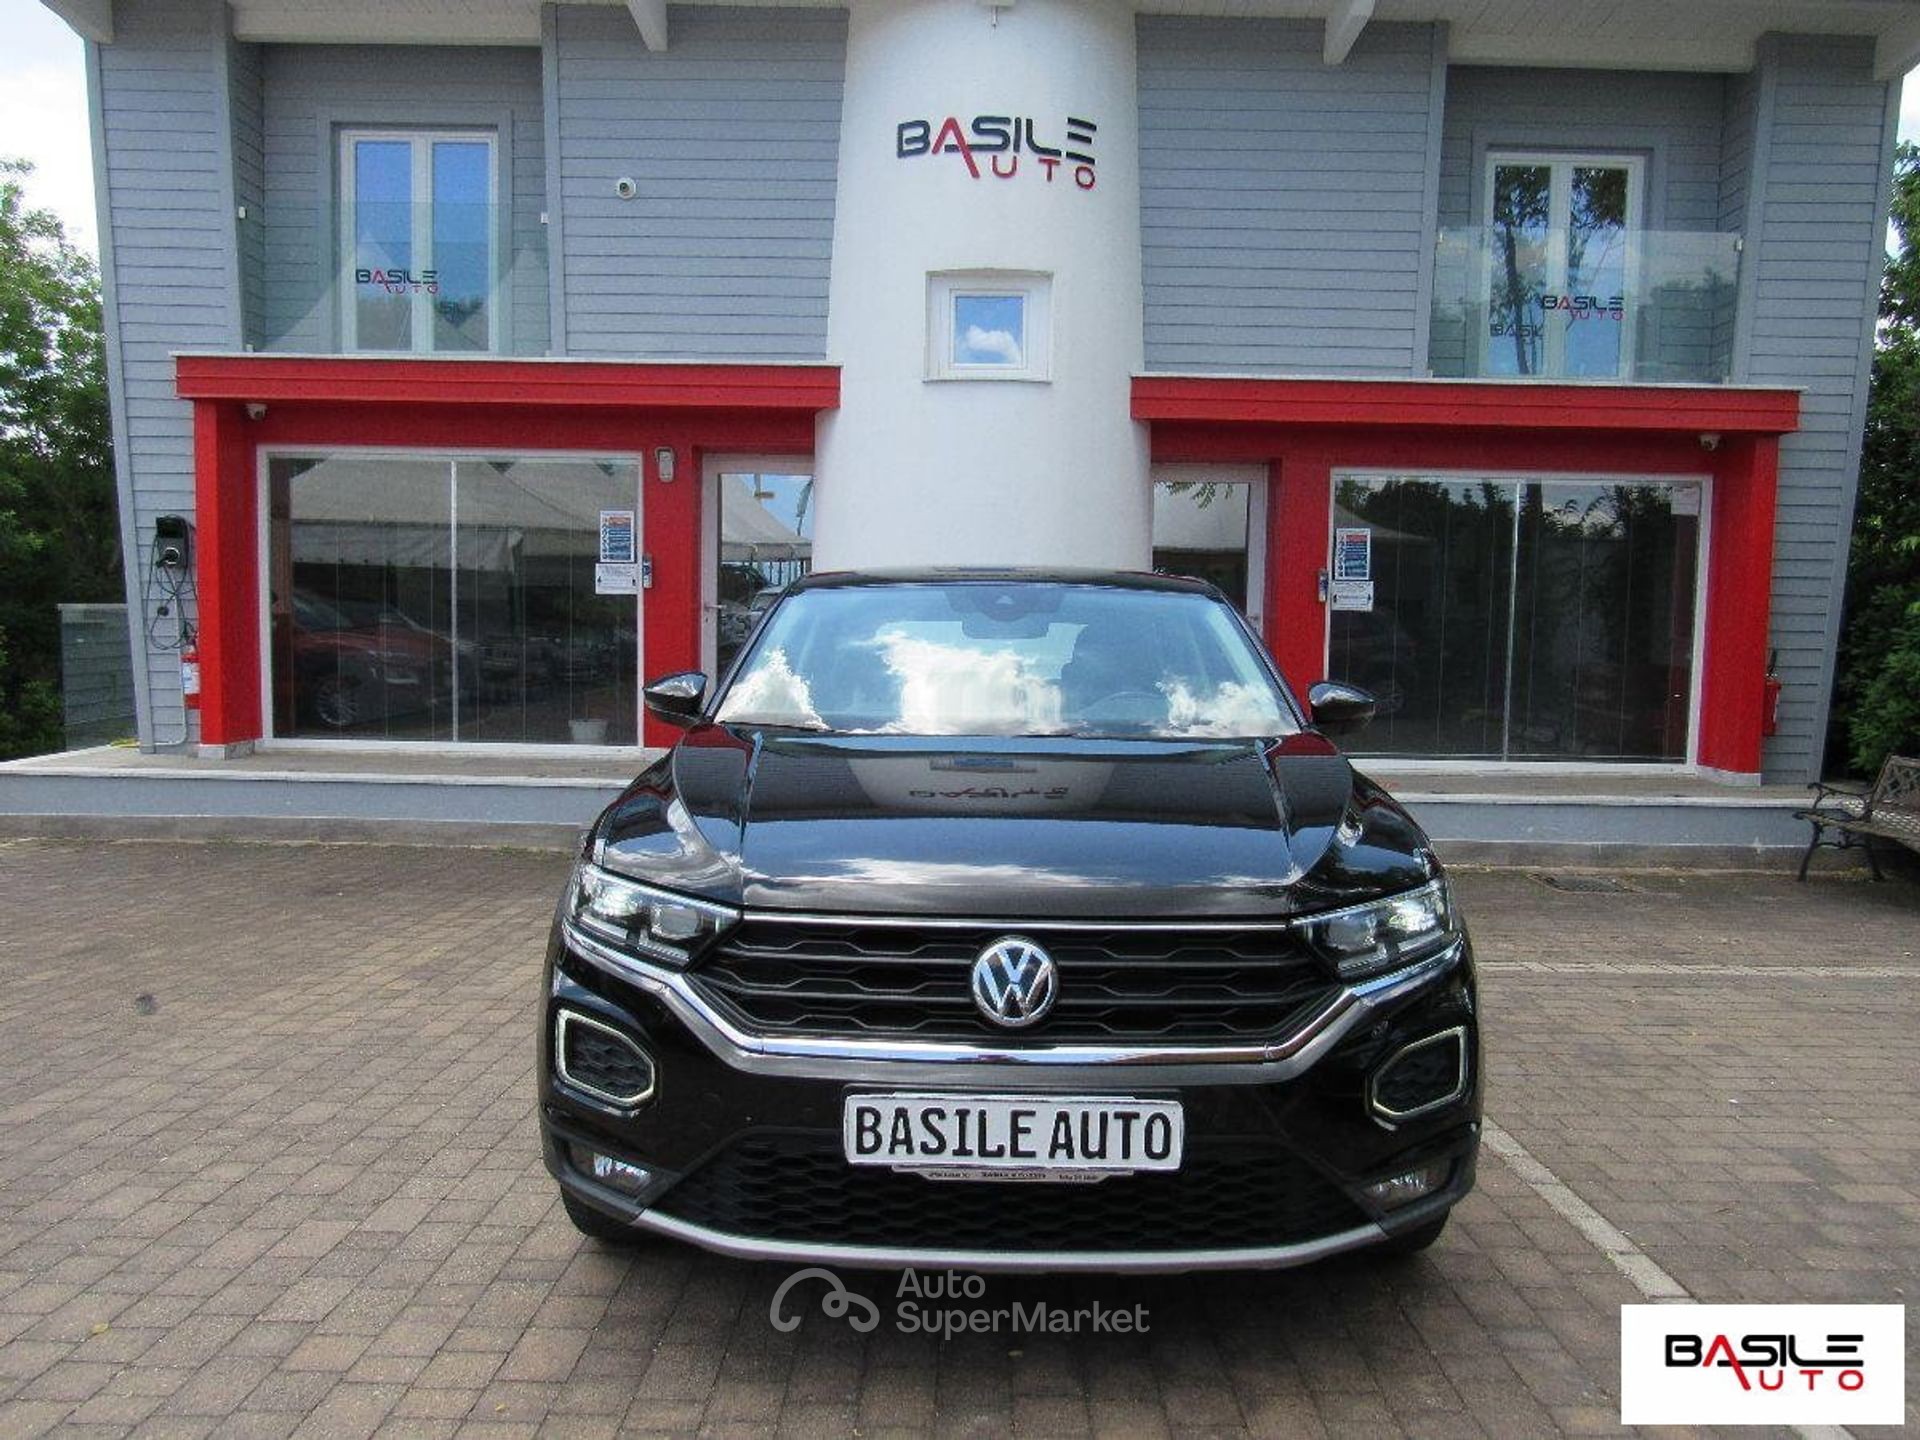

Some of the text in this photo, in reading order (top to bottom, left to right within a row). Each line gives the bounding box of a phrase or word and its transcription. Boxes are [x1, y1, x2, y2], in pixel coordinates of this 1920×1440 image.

[897, 116, 1097, 179] BASILE
[355, 267, 438, 293] BASILE
[1541, 295, 1624, 319] BASILE
[856, 1106, 1172, 1160] BASILE AUTO
